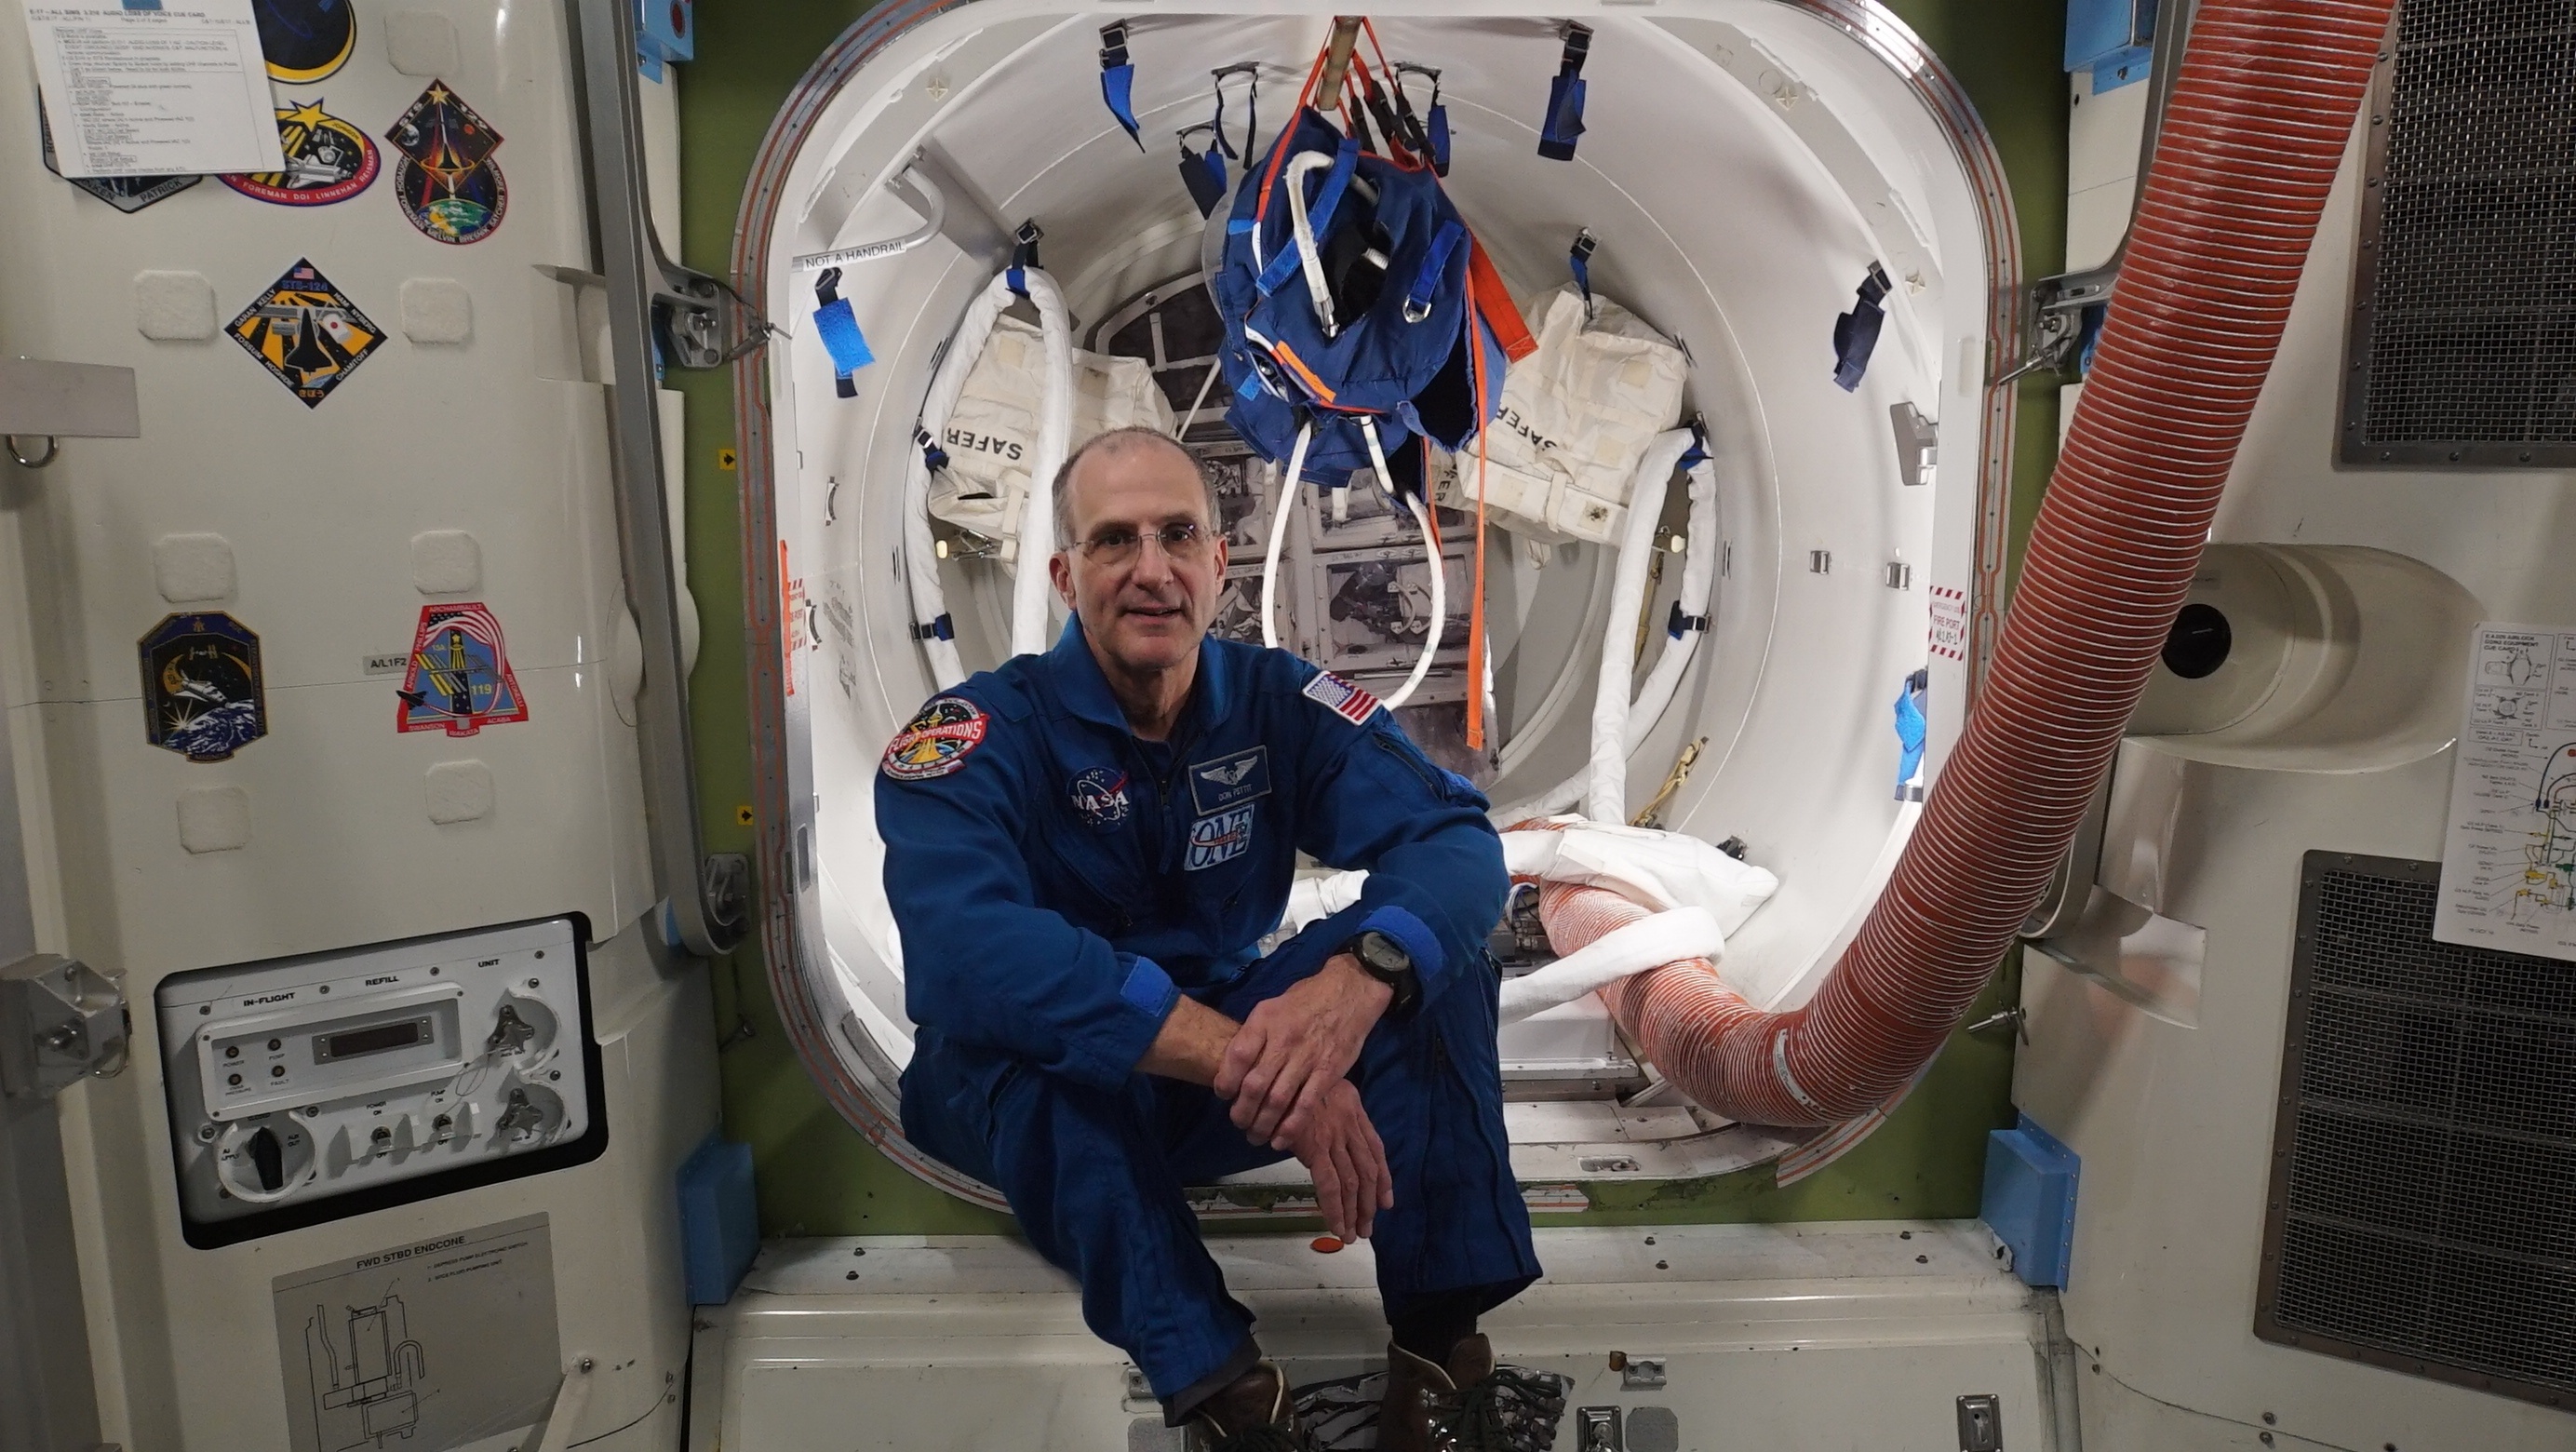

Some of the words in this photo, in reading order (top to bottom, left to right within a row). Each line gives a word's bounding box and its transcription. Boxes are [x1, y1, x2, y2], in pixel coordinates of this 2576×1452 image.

[398, 102, 423, 128] STS
[460, 103, 489, 130] 129
[243, 182, 288, 200] FOREMAN
[315, 182, 357, 200] LINNEHAN
[359, 148, 374, 182] REISMAN
[139, 178, 183, 203] PATRICK
[426, 227, 456, 244] MELVIN
[805, 254, 830, 268] NOT
[835, 253, 844, 263] A
[845, 240, 905, 261] HANDRAIL
[235, 307, 259, 328] GARAN
[256, 288, 277, 307] KELLY
[333, 292, 351, 308] HAM
[351, 308, 377, 333] NYBERG
[234, 332, 263, 360] FOSSUM
[265, 360, 295, 387] HOSHIDE
[335, 348, 369, 382] CHAMITOFF
[946, 427, 1024, 461] SAFER
[429, 604, 482, 612] ARCHAMBAULT
[1933, 614, 1946, 627] FIRE
[1946, 617, 1960, 630] PORT
[370, 657, 407, 668] A/L1F2
[406, 660, 418, 689] ARNOLD
[415, 622, 428, 652] PHILLIPS
[471, 684, 492, 695] 119
[505, 673, 525, 708] ANTONELLI
[408, 722, 446, 732] SWANSON
[448, 728, 479, 737] WAKATA
[487, 716, 512, 724] ACABA
[921, 720, 983, 740] OPERATIONS
[1070, 789, 1130, 811] NASA
[1218, 790, 1232, 801] DON
[1233, 784, 1254, 798] PETTIT
[1191, 807, 1253, 867] ONE
[243, 992, 296, 1007] IN-FLIGHT
[365, 975, 400, 987] REFILL
[477, 959, 501, 968] UNIT
[356, 1257, 381, 1269] FWD
[383, 1249, 412, 1263] STBD
[414, 1235, 465, 1255] ENDCONE
